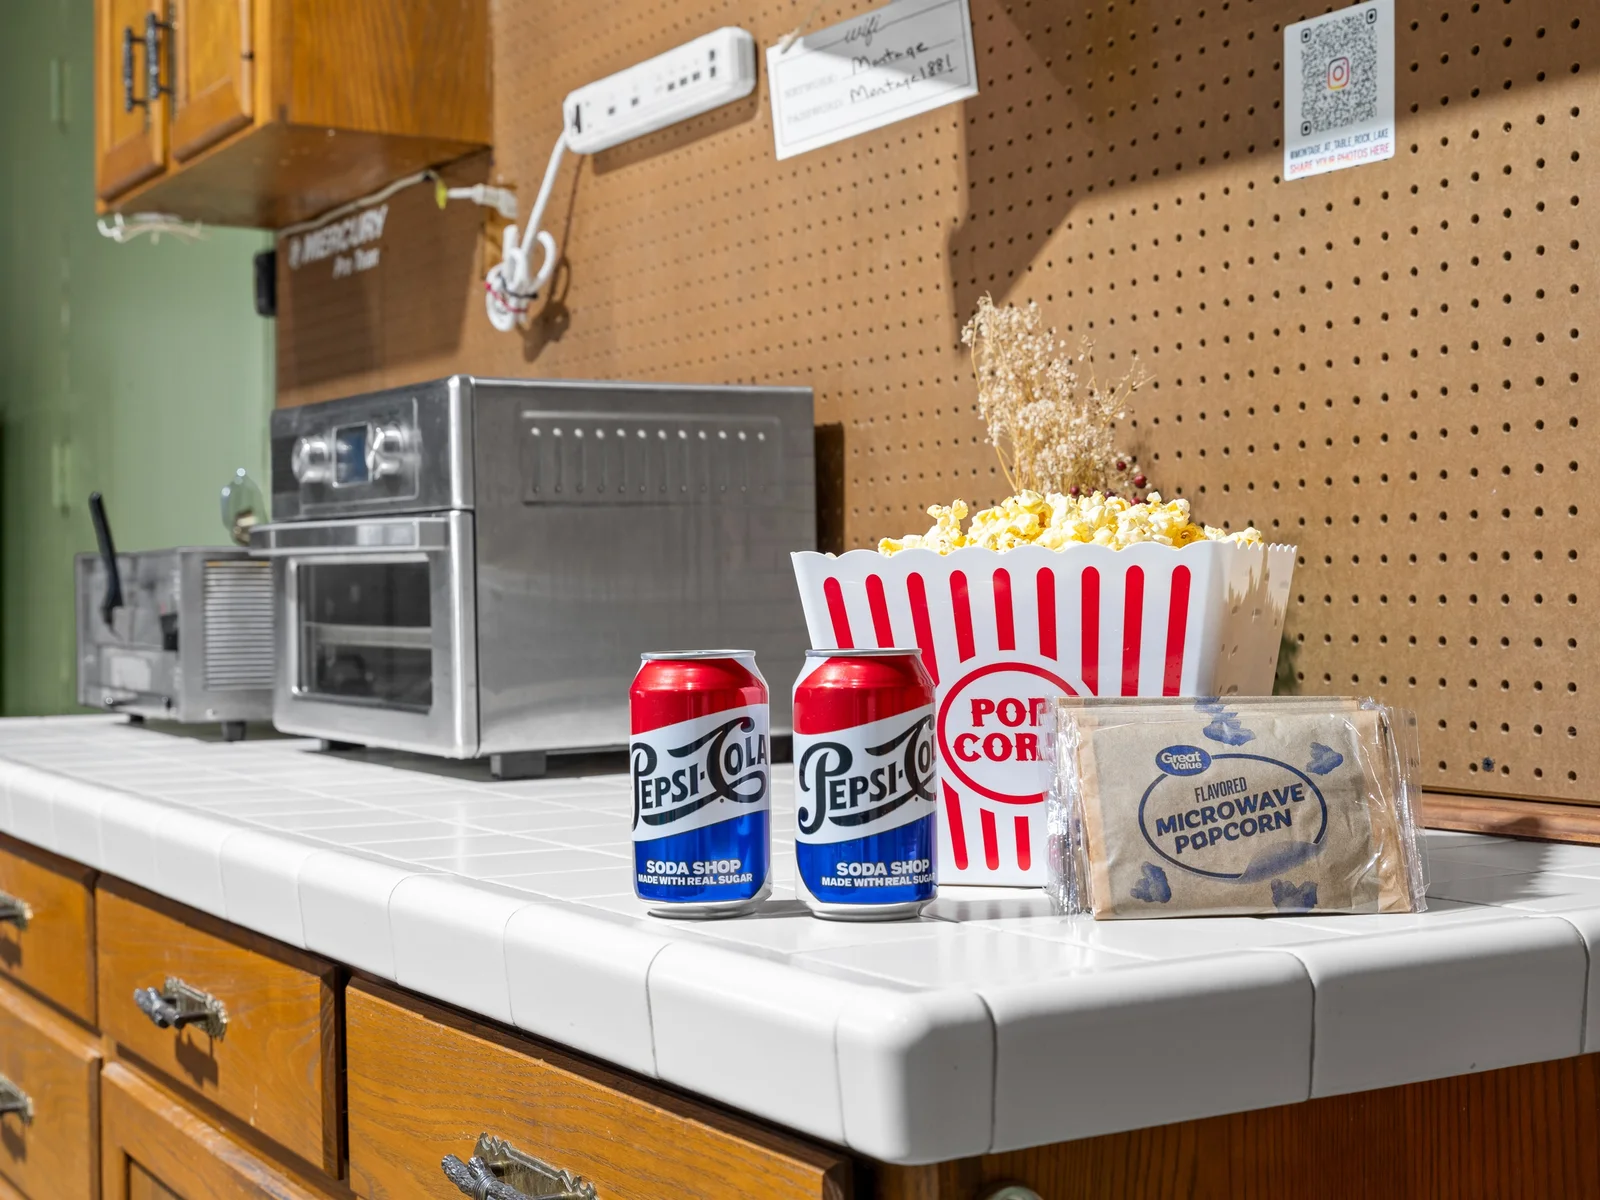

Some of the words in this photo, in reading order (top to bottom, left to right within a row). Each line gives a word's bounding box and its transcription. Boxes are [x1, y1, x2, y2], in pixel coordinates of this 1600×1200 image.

[852, 42, 929, 75] Montage
[1290, 160, 1313, 174] SHARE
[1337, 147, 1368, 164] PHOTOS
[1370, 142, 1390, 157] HERE
[303, 204, 389, 263] MERCURY
[1161, 751, 1201, 764] Great
[1172, 761, 1202, 770] Value
[1194, 776, 1248, 803] FLAVORED
[1155, 782, 1306, 837] MICROWAVE
[1174, 808, 1294, 855] POPCORN
[646, 860, 689, 875] SODA
[692, 860, 741, 875] SHOP
[836, 862, 888, 876] SODA
[890, 859, 930, 875] SHOP
[638, 873, 658, 885] MADE
[659, 876, 686, 886] WITH
[687, 876, 716, 886] REAL
[718, 873, 753, 884] SUGAR
[821, 876, 852, 887] MADE
[854, 877, 884, 888] WITH
[885, 876, 912, 887] REAL
